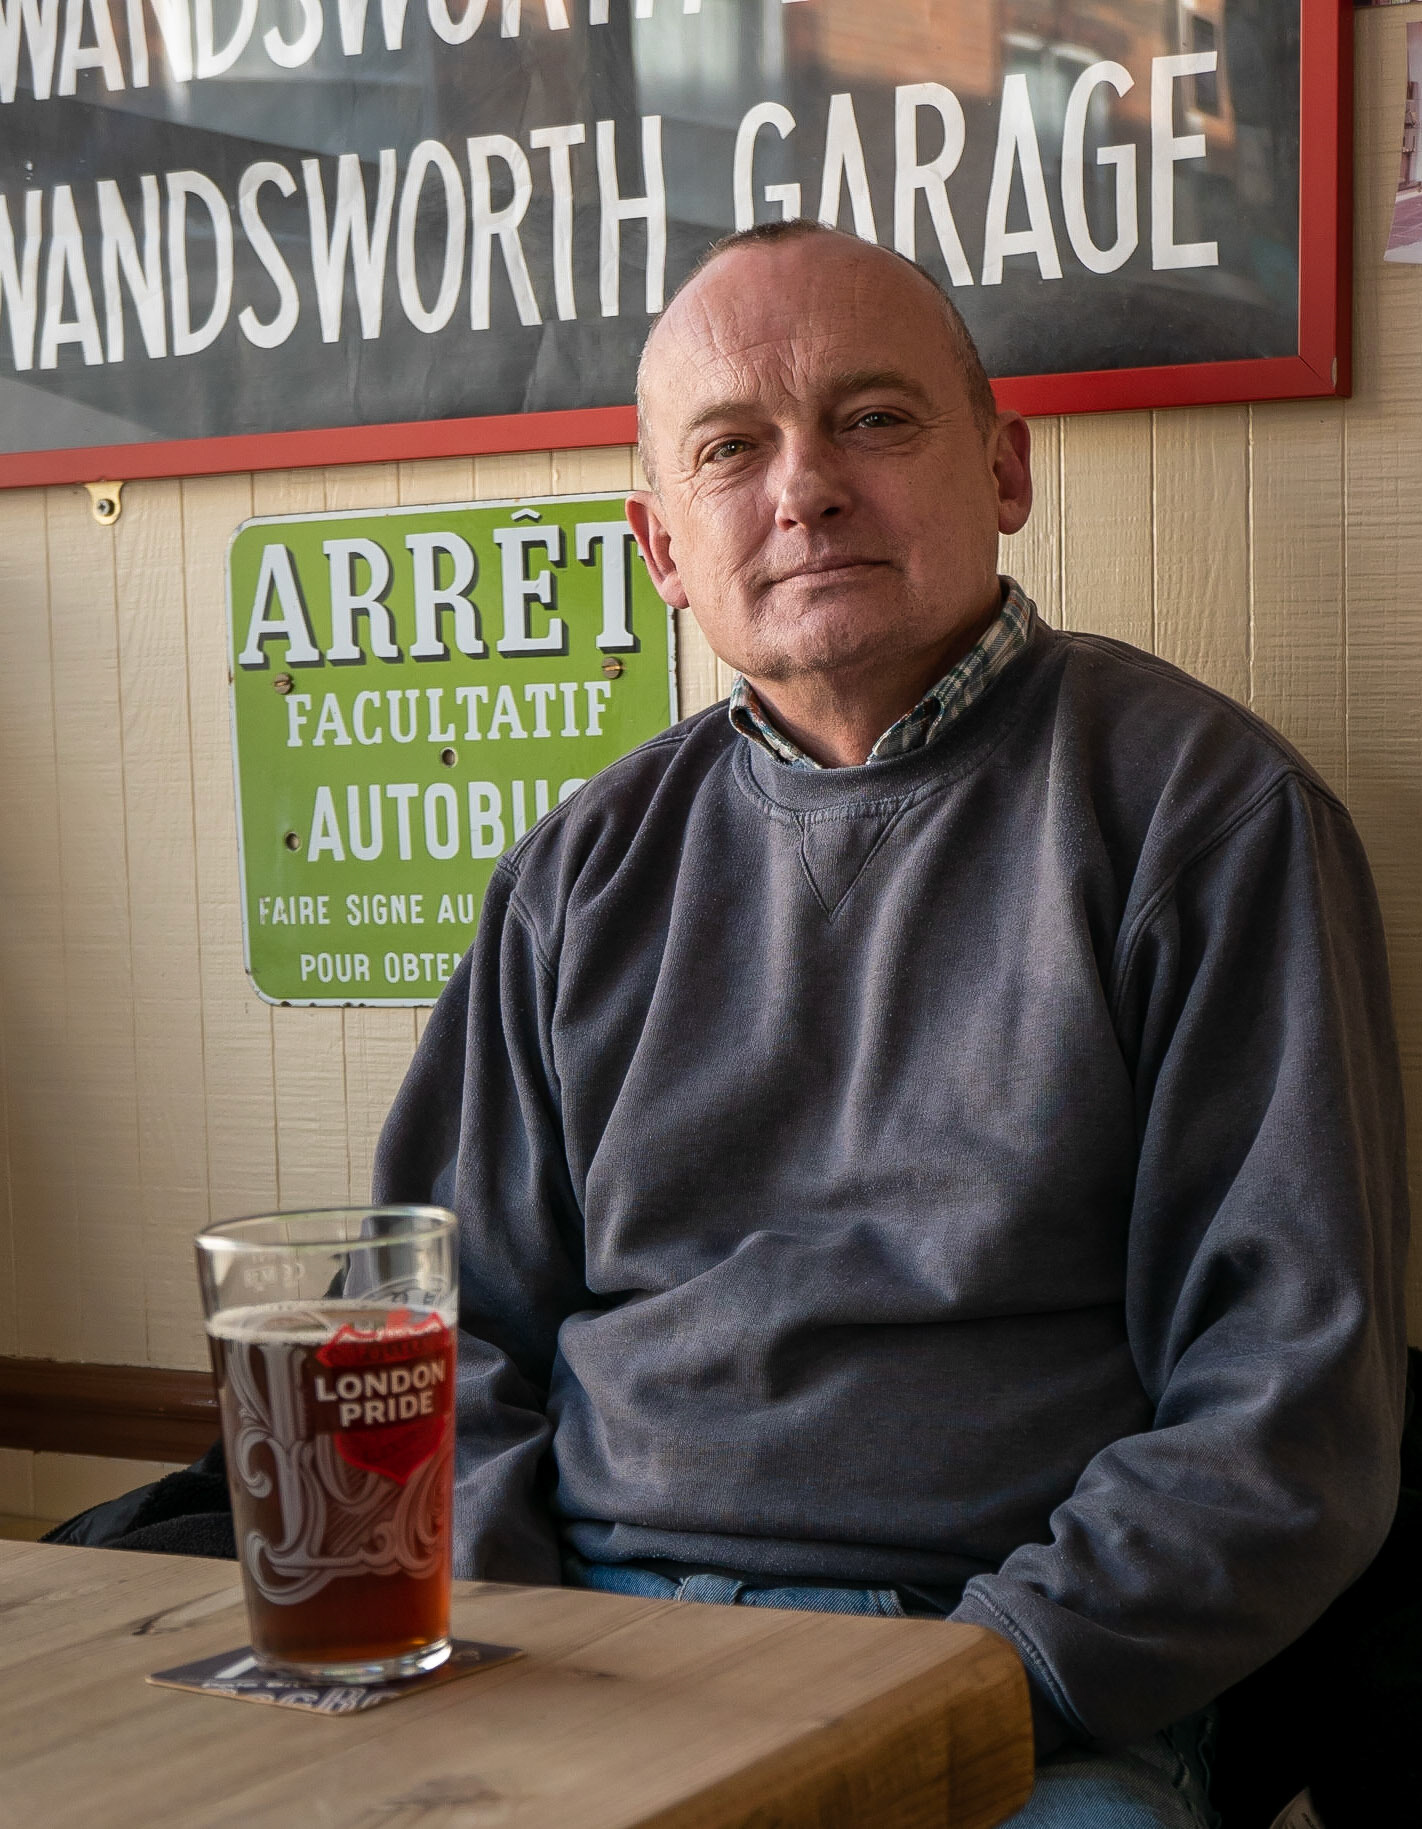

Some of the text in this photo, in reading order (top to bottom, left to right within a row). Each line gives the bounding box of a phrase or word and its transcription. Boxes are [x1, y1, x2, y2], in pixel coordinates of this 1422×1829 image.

[733, 51, 1219, 287] GARAGE
[238, 507, 642, 668] ARRÊT
[286, 681, 611, 747] FACULTATIF
[307, 778, 588, 862] AUTOBU
[259, 894, 474, 926] FAIRE SIGNE AU
[301, 952, 370, 984] POUR
[314, 1359, 445, 1401] LONDON
[340, 1391, 434, 1427] PRIDE
